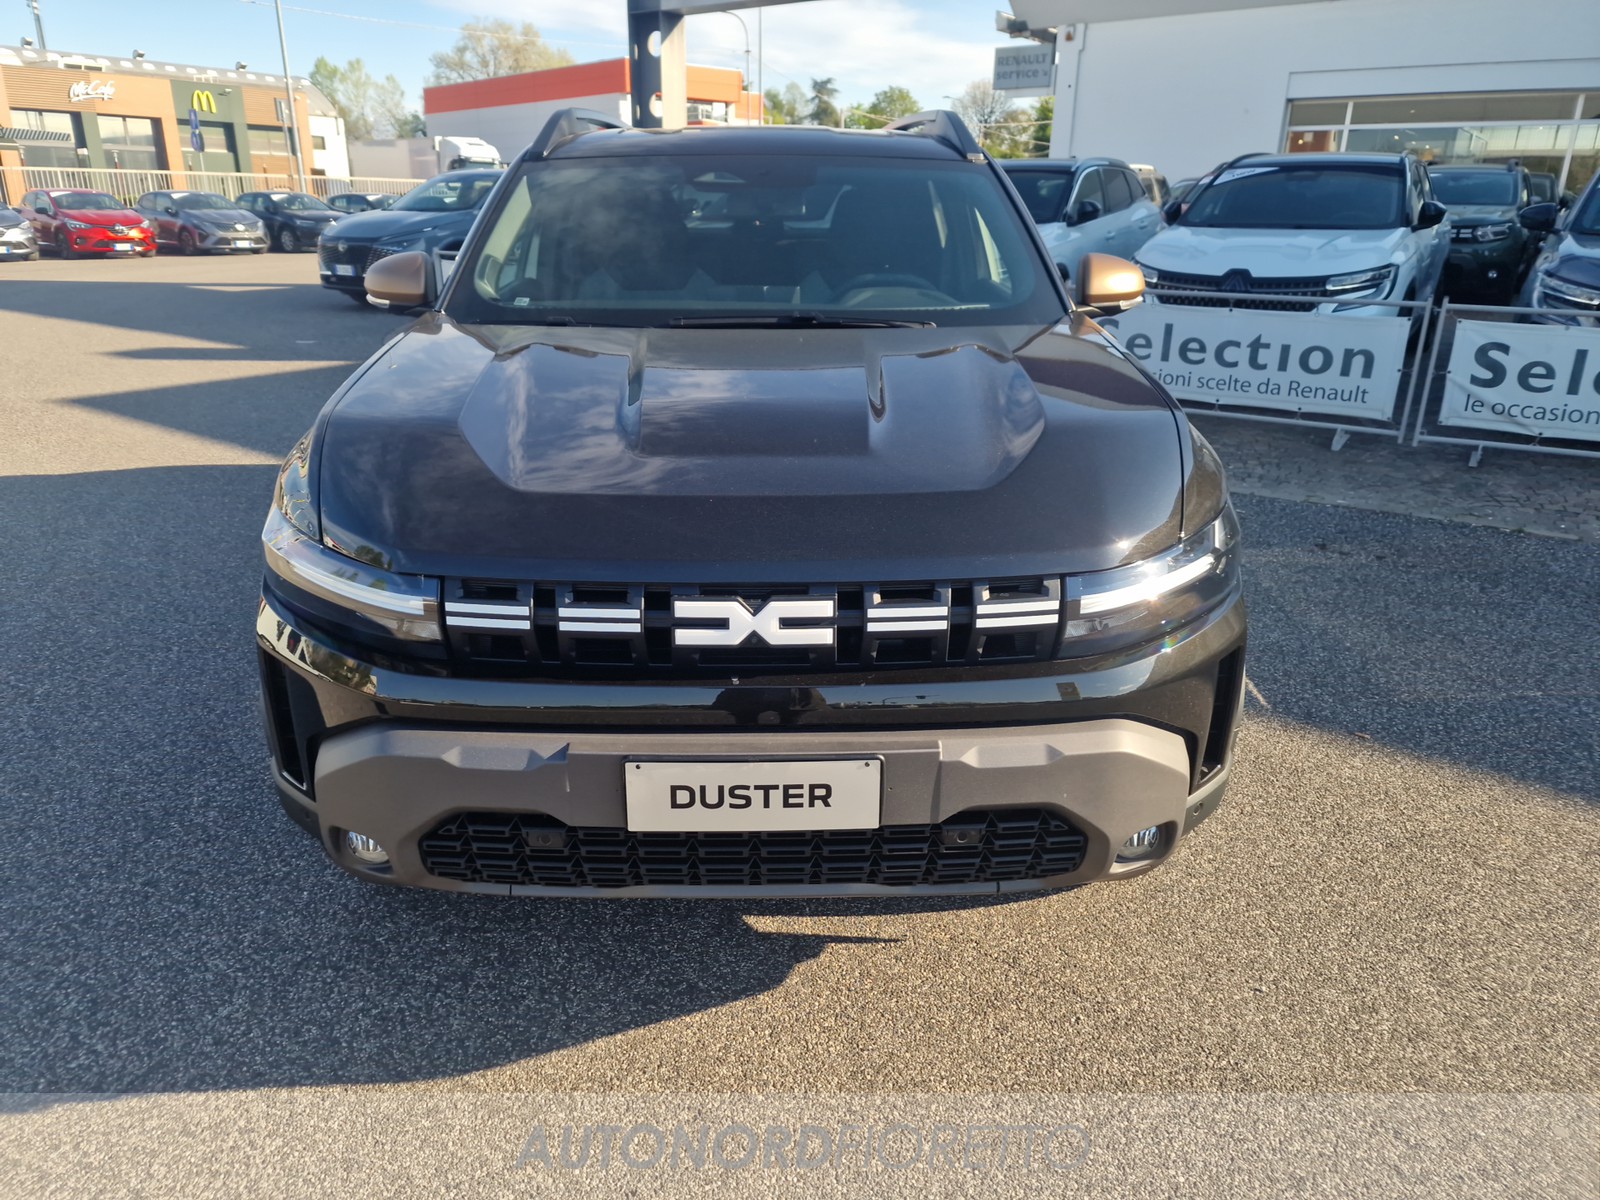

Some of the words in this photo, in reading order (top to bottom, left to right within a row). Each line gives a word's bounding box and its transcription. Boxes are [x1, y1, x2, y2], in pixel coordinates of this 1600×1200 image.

[997, 53, 1048, 66] RENAULT
[996, 69, 1040, 80] service
[1470, 341, 1600, 396] Sel
[1153, 368, 1192, 388] ioni
[1197, 373, 1252, 393] scelte
[1257, 377, 1281, 396] da
[1287, 381, 1369, 404] Renault
[1464, 393, 1484, 413] le
[670, 784, 832, 809] DUSTER
